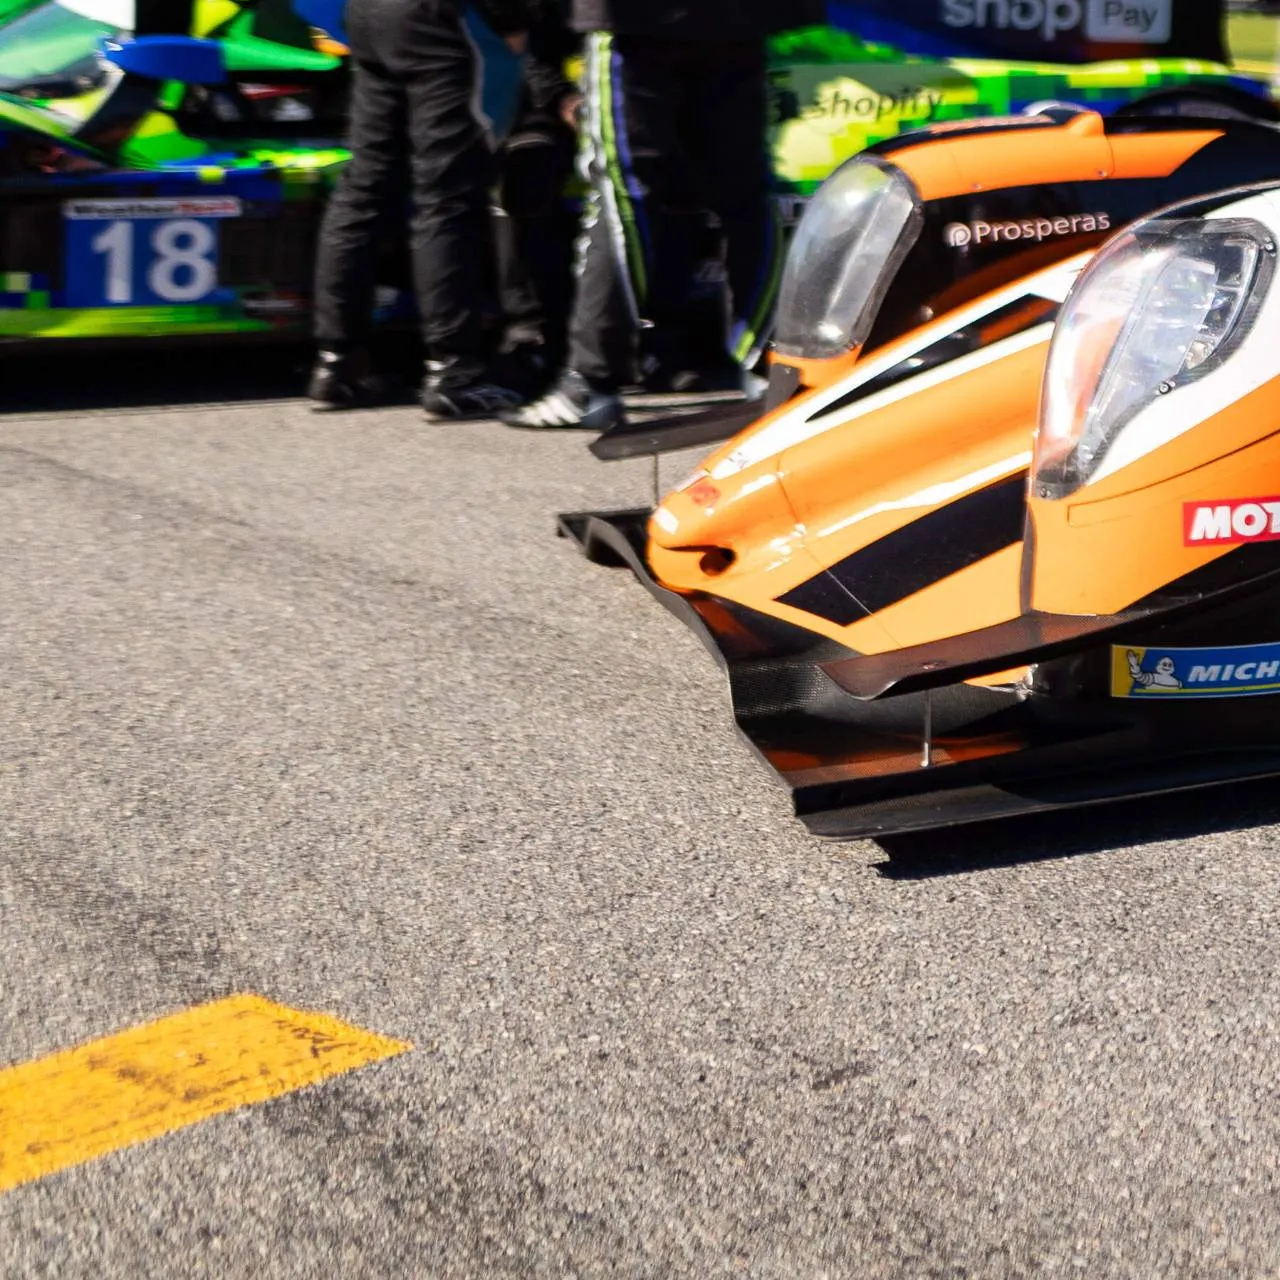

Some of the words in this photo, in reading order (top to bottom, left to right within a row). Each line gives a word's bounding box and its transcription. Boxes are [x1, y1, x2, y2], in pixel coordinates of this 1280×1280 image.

[1102, 0, 1159, 33] Pay
[811, 86, 945, 124] shopify
[974, 212, 1111, 245] Prosperas
[90, 220, 218, 303] 18
